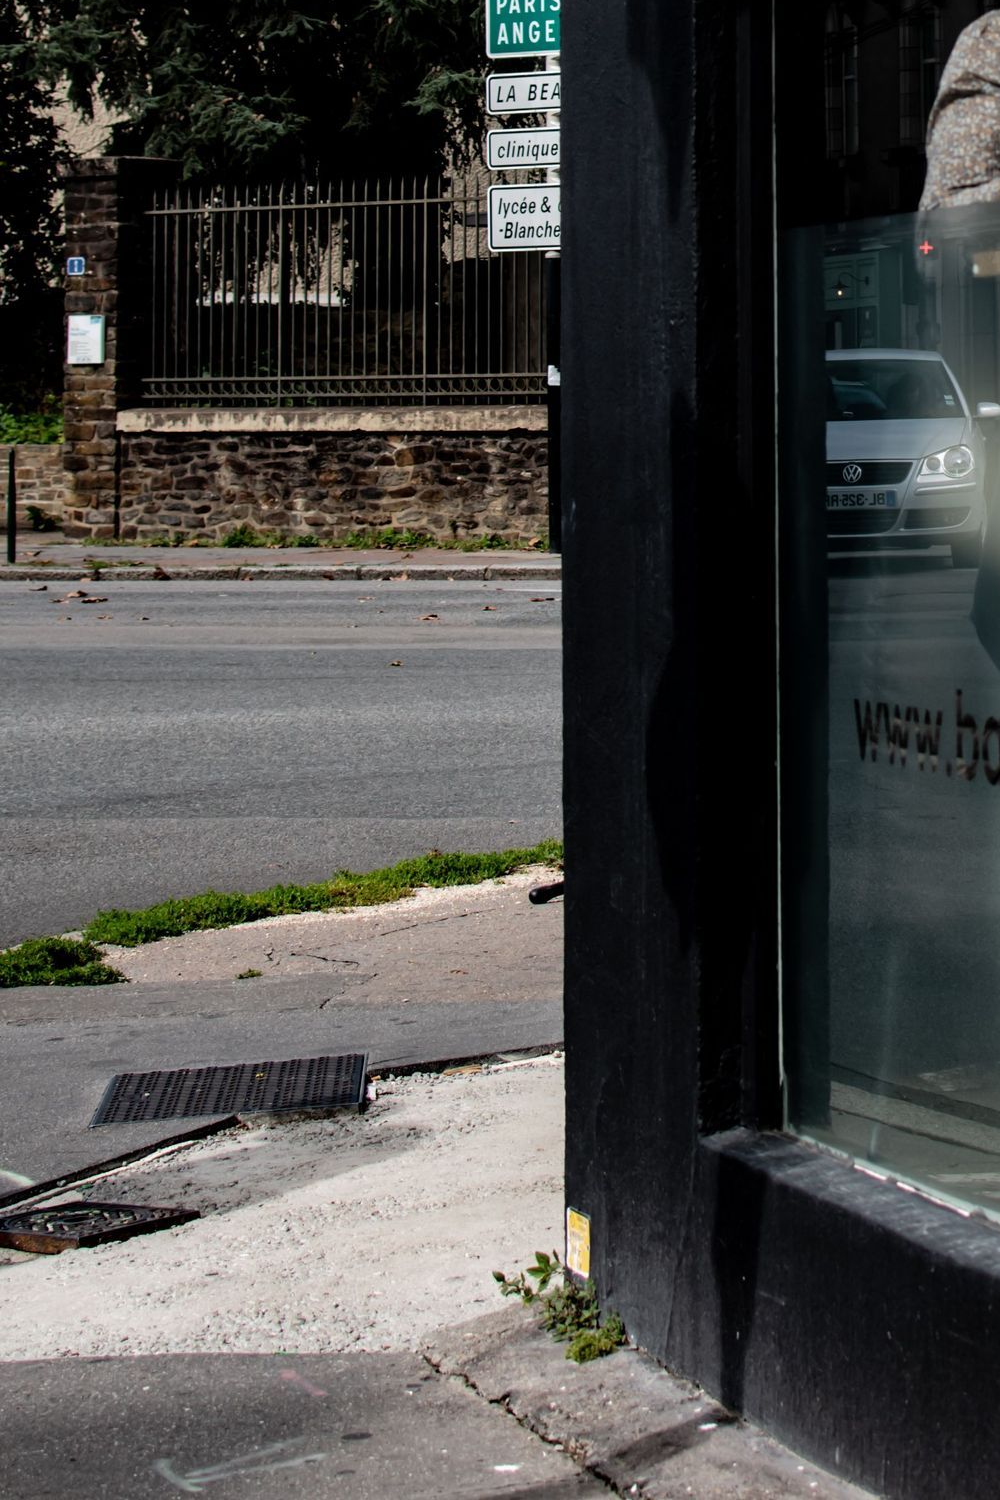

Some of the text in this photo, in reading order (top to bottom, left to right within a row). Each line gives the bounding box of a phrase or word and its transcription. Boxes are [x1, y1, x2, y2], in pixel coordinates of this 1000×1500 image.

[497, 20, 555, 45] ANGE
[497, 82, 561, 103] LA BEA
[497, 140, 559, 161] clinique
[498, 197, 536, 218] lycée
[541, 196, 551, 213] &
